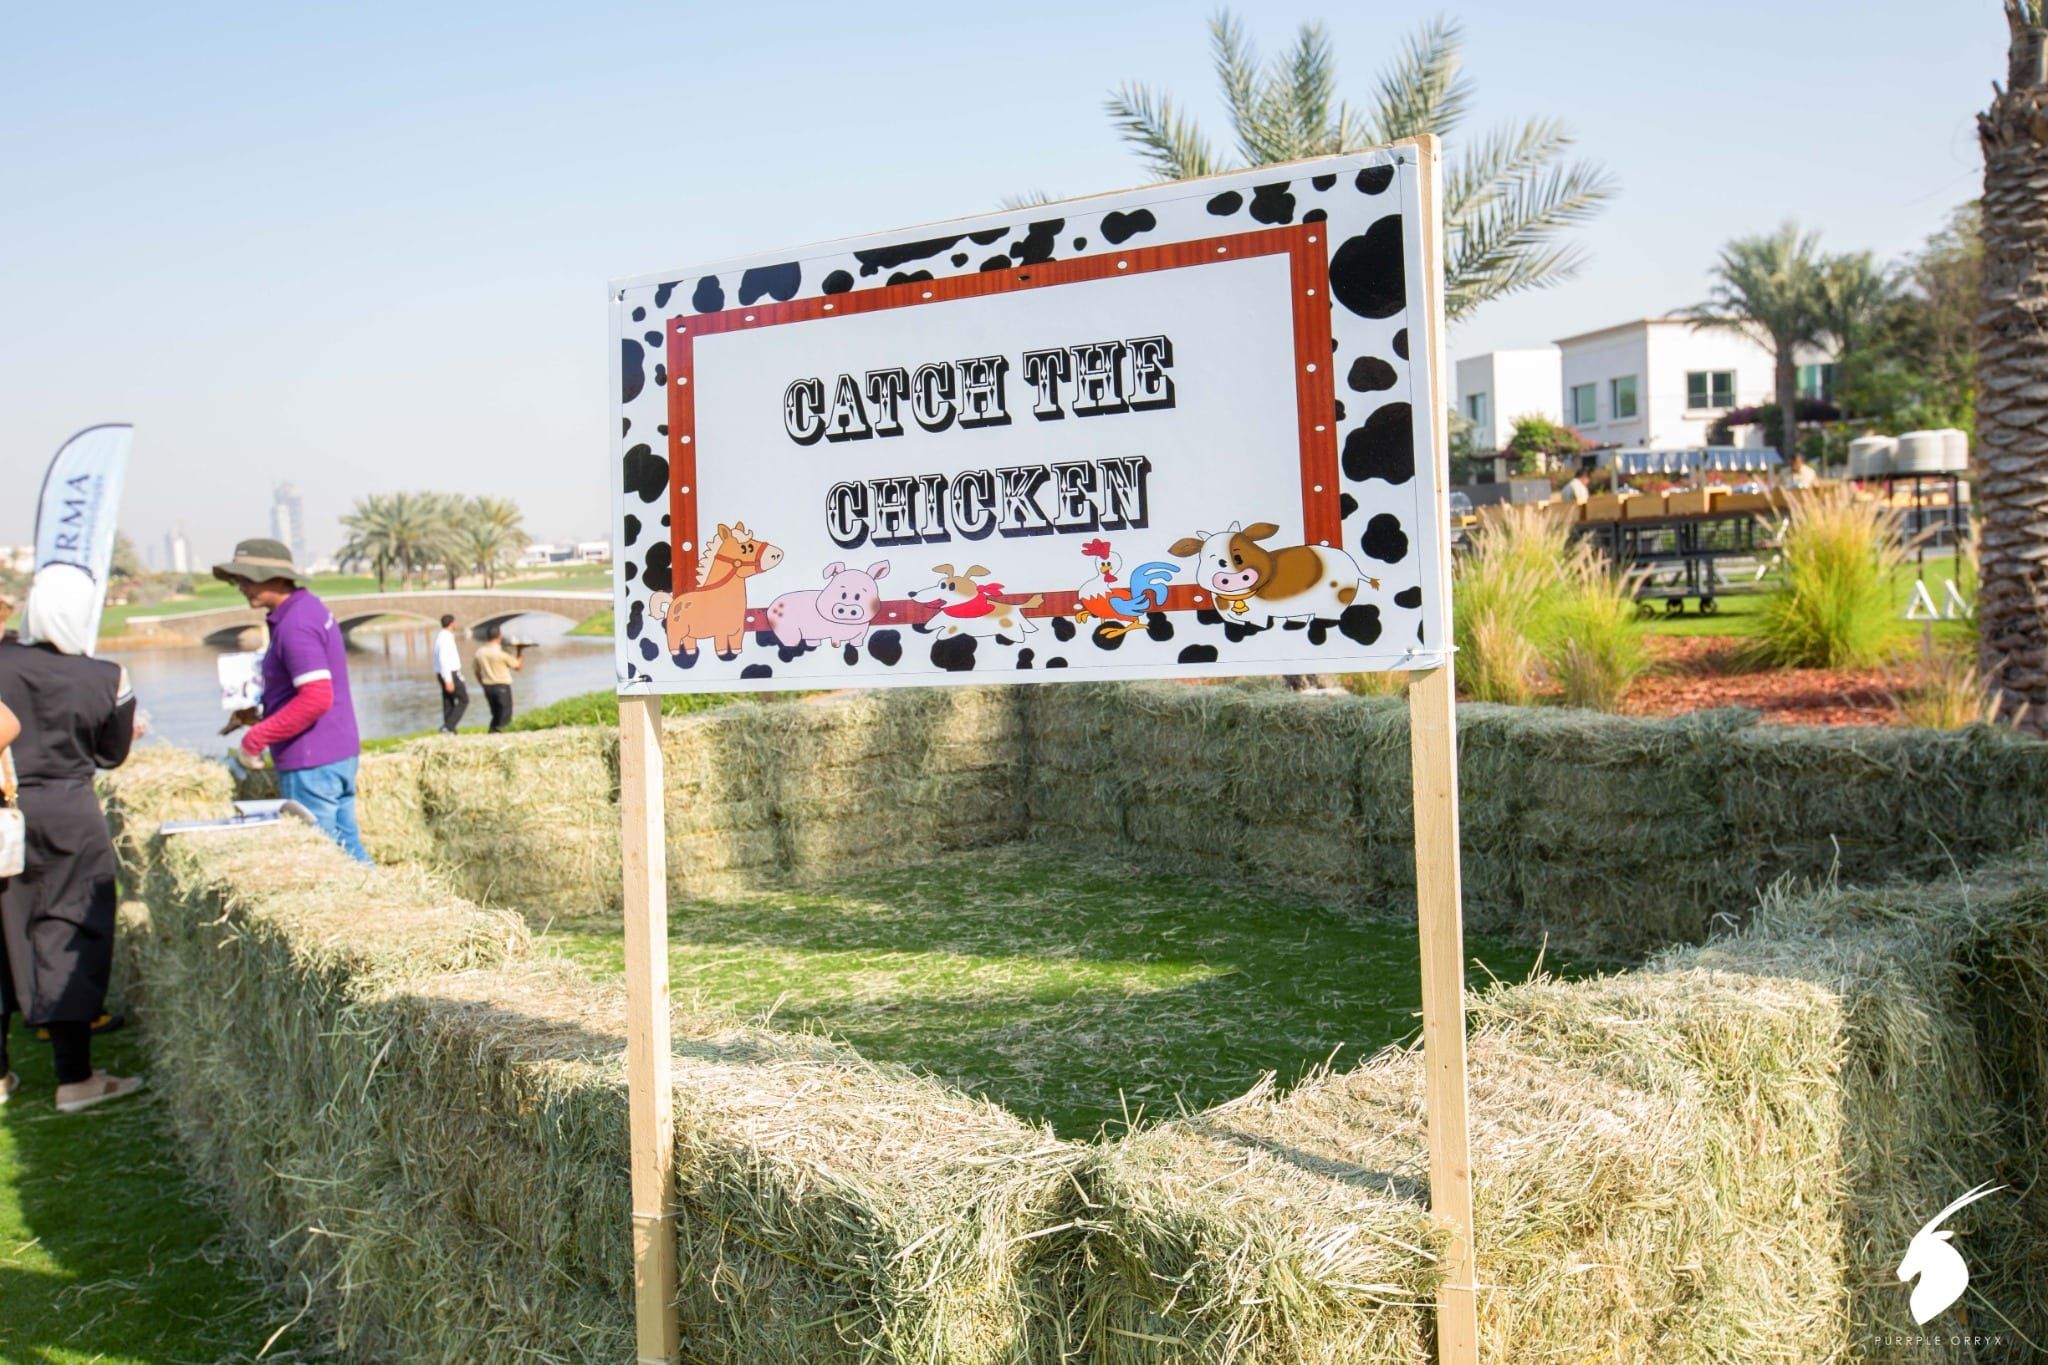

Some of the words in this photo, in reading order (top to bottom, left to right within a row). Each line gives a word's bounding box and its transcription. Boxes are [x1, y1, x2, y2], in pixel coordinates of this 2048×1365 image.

[784, 355, 1012, 446] CATCH
[1022, 334, 1176, 422] THE
[54, 473, 90, 562] RMA
[825, 454, 1152, 549] CHICKEN
